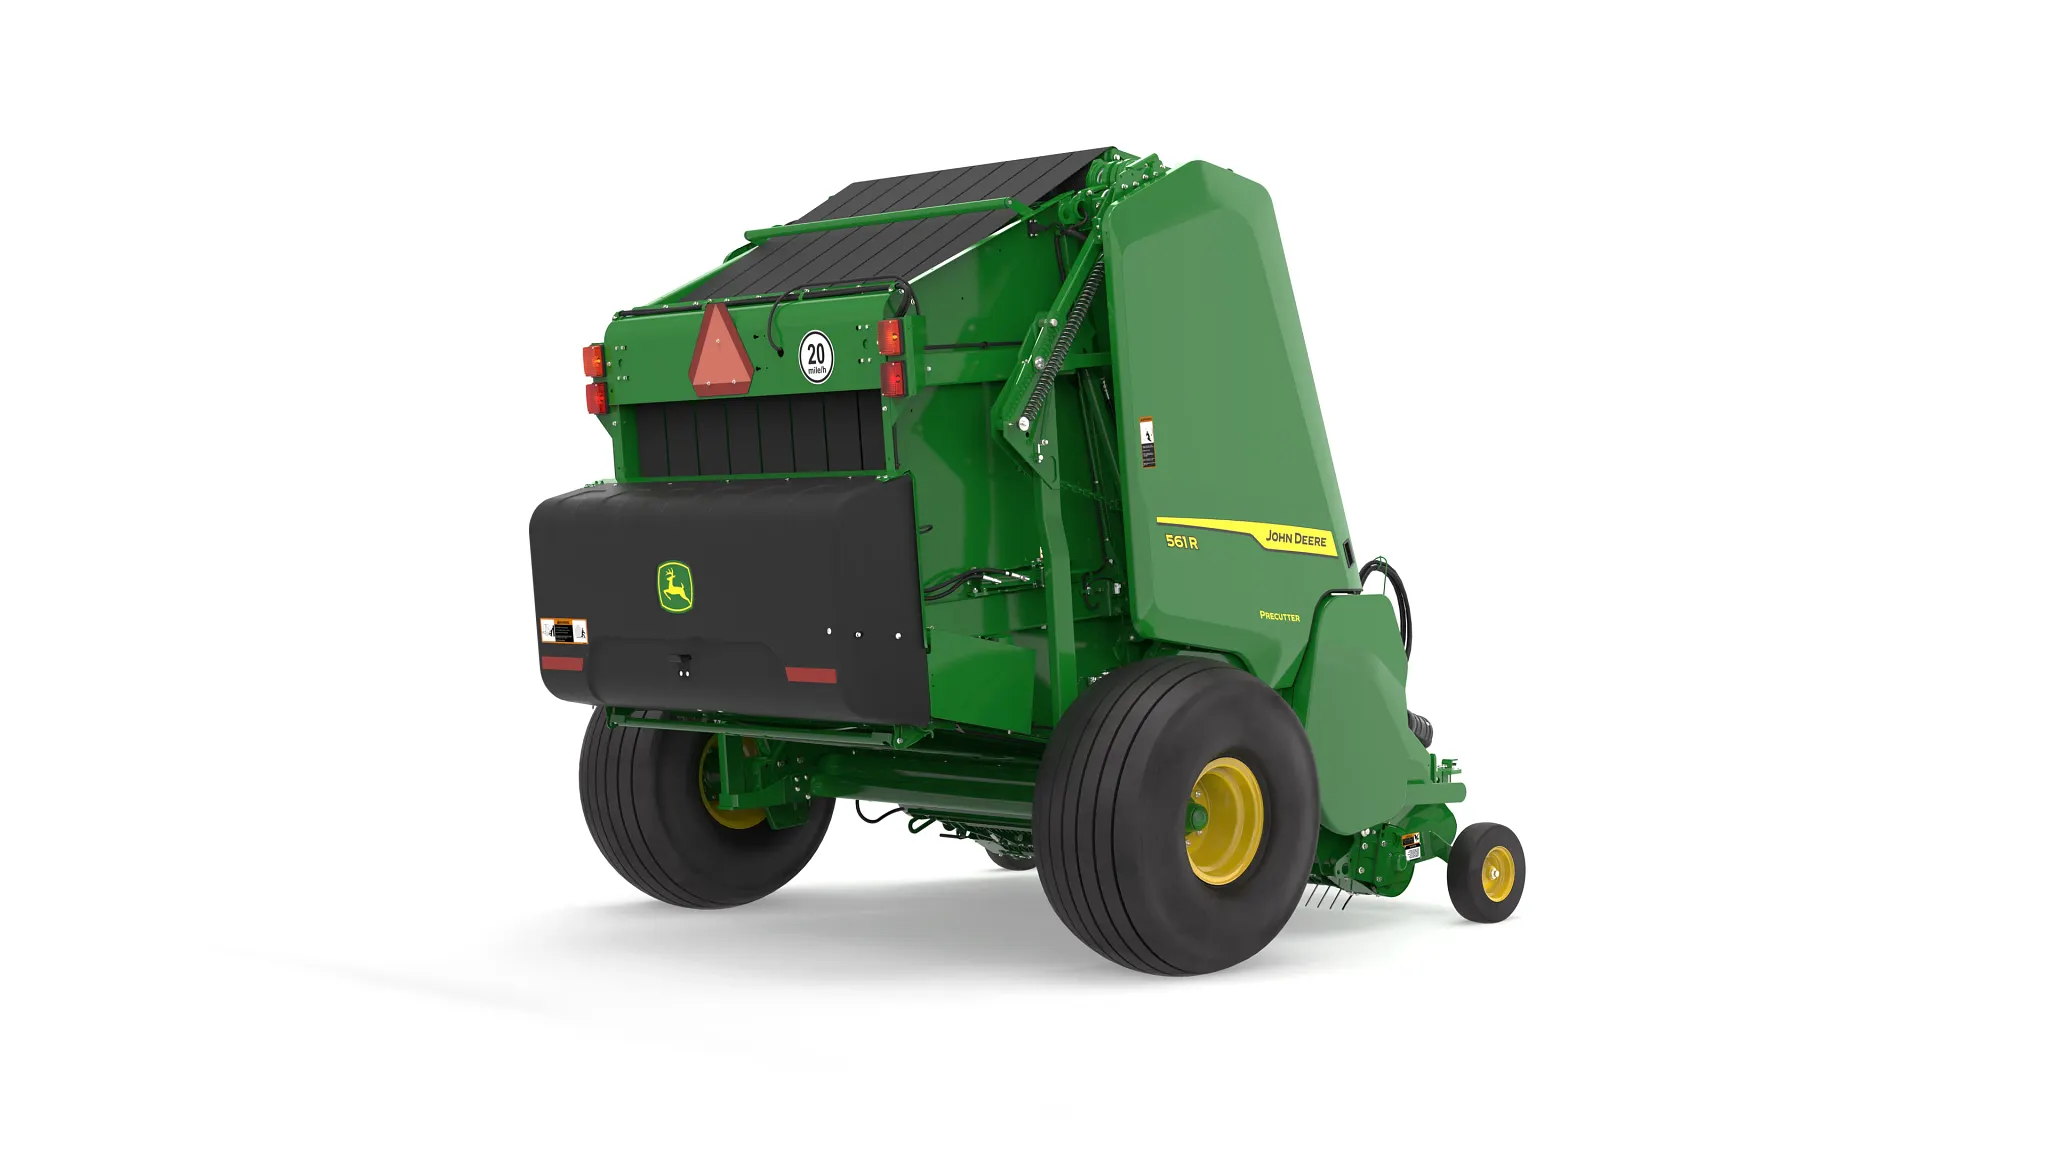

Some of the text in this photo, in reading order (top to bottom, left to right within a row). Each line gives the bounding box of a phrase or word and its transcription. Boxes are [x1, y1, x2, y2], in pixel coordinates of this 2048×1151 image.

[808, 343, 825, 364] 20
[808, 366, 827, 374] mile/h
[1266, 530, 1327, 547] JOHN DEERE
[1259, 610, 1301, 622] PRECUTTER
